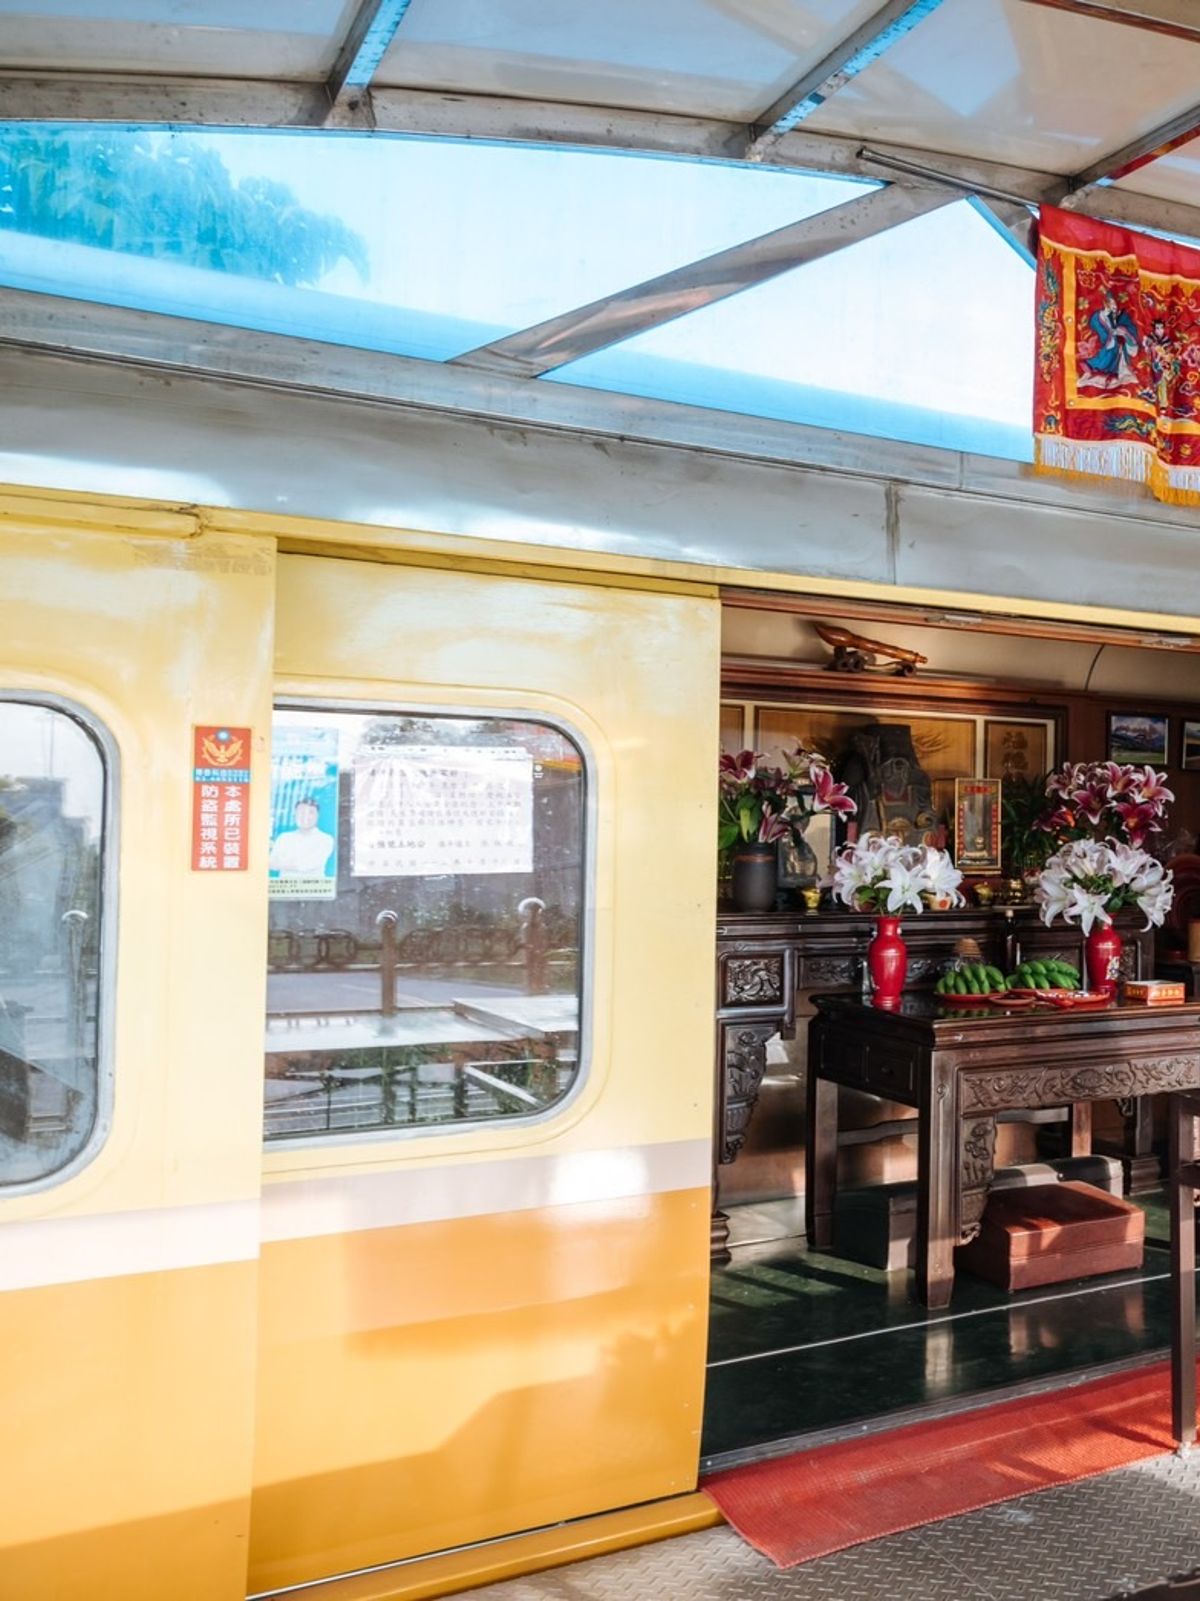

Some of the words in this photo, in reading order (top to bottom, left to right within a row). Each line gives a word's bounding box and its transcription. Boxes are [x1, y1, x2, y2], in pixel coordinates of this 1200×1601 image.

[199, 784, 219, 869] 防盜監視系統
[223, 785, 242, 869] 本處所已裝置
